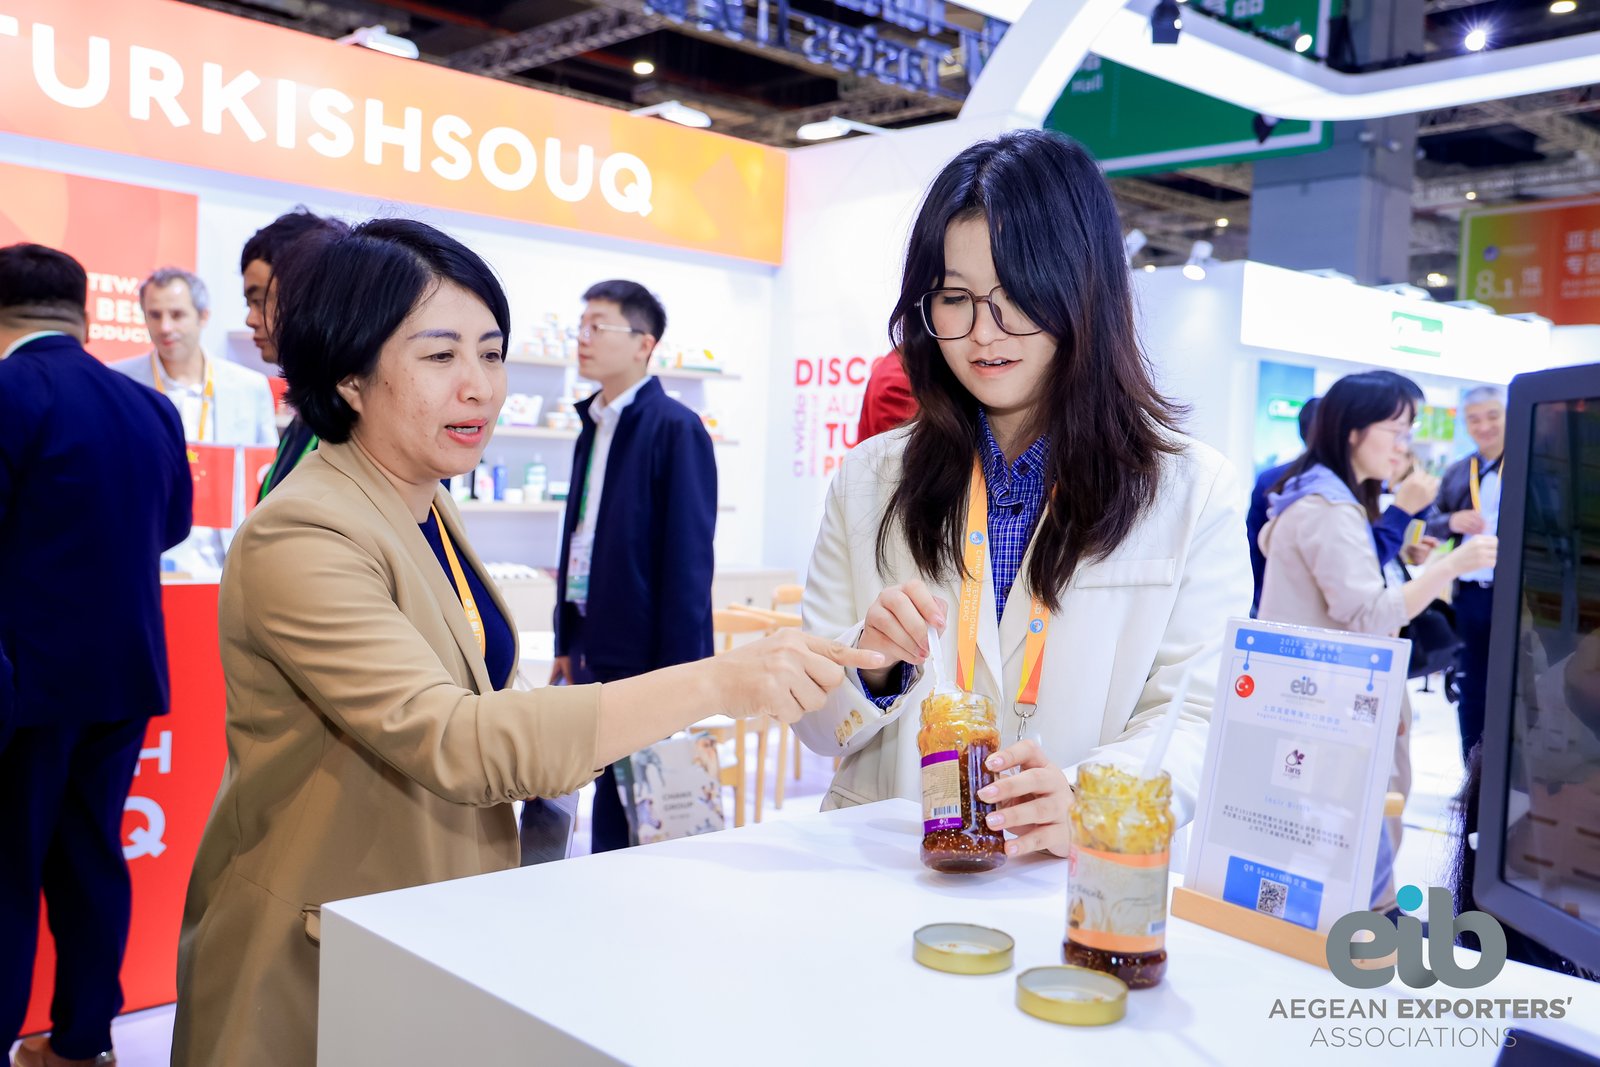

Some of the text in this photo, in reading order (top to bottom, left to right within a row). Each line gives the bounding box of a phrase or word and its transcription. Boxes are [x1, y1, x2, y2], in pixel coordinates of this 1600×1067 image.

[87, 272, 140, 296] TEW
[96, 297, 146, 325] BES
[88, 323, 151, 344] ODUCT
[826, 423, 859, 449] TU
[824, 456, 843, 476] P
[962, 567, 974, 622] IORT EXPO
[968, 549, 983, 641] CHINA INTERNATIONAL
[1290, 676, 1318, 697] eib
[134, 731, 172, 775] H
[121, 796, 167, 860] Q
